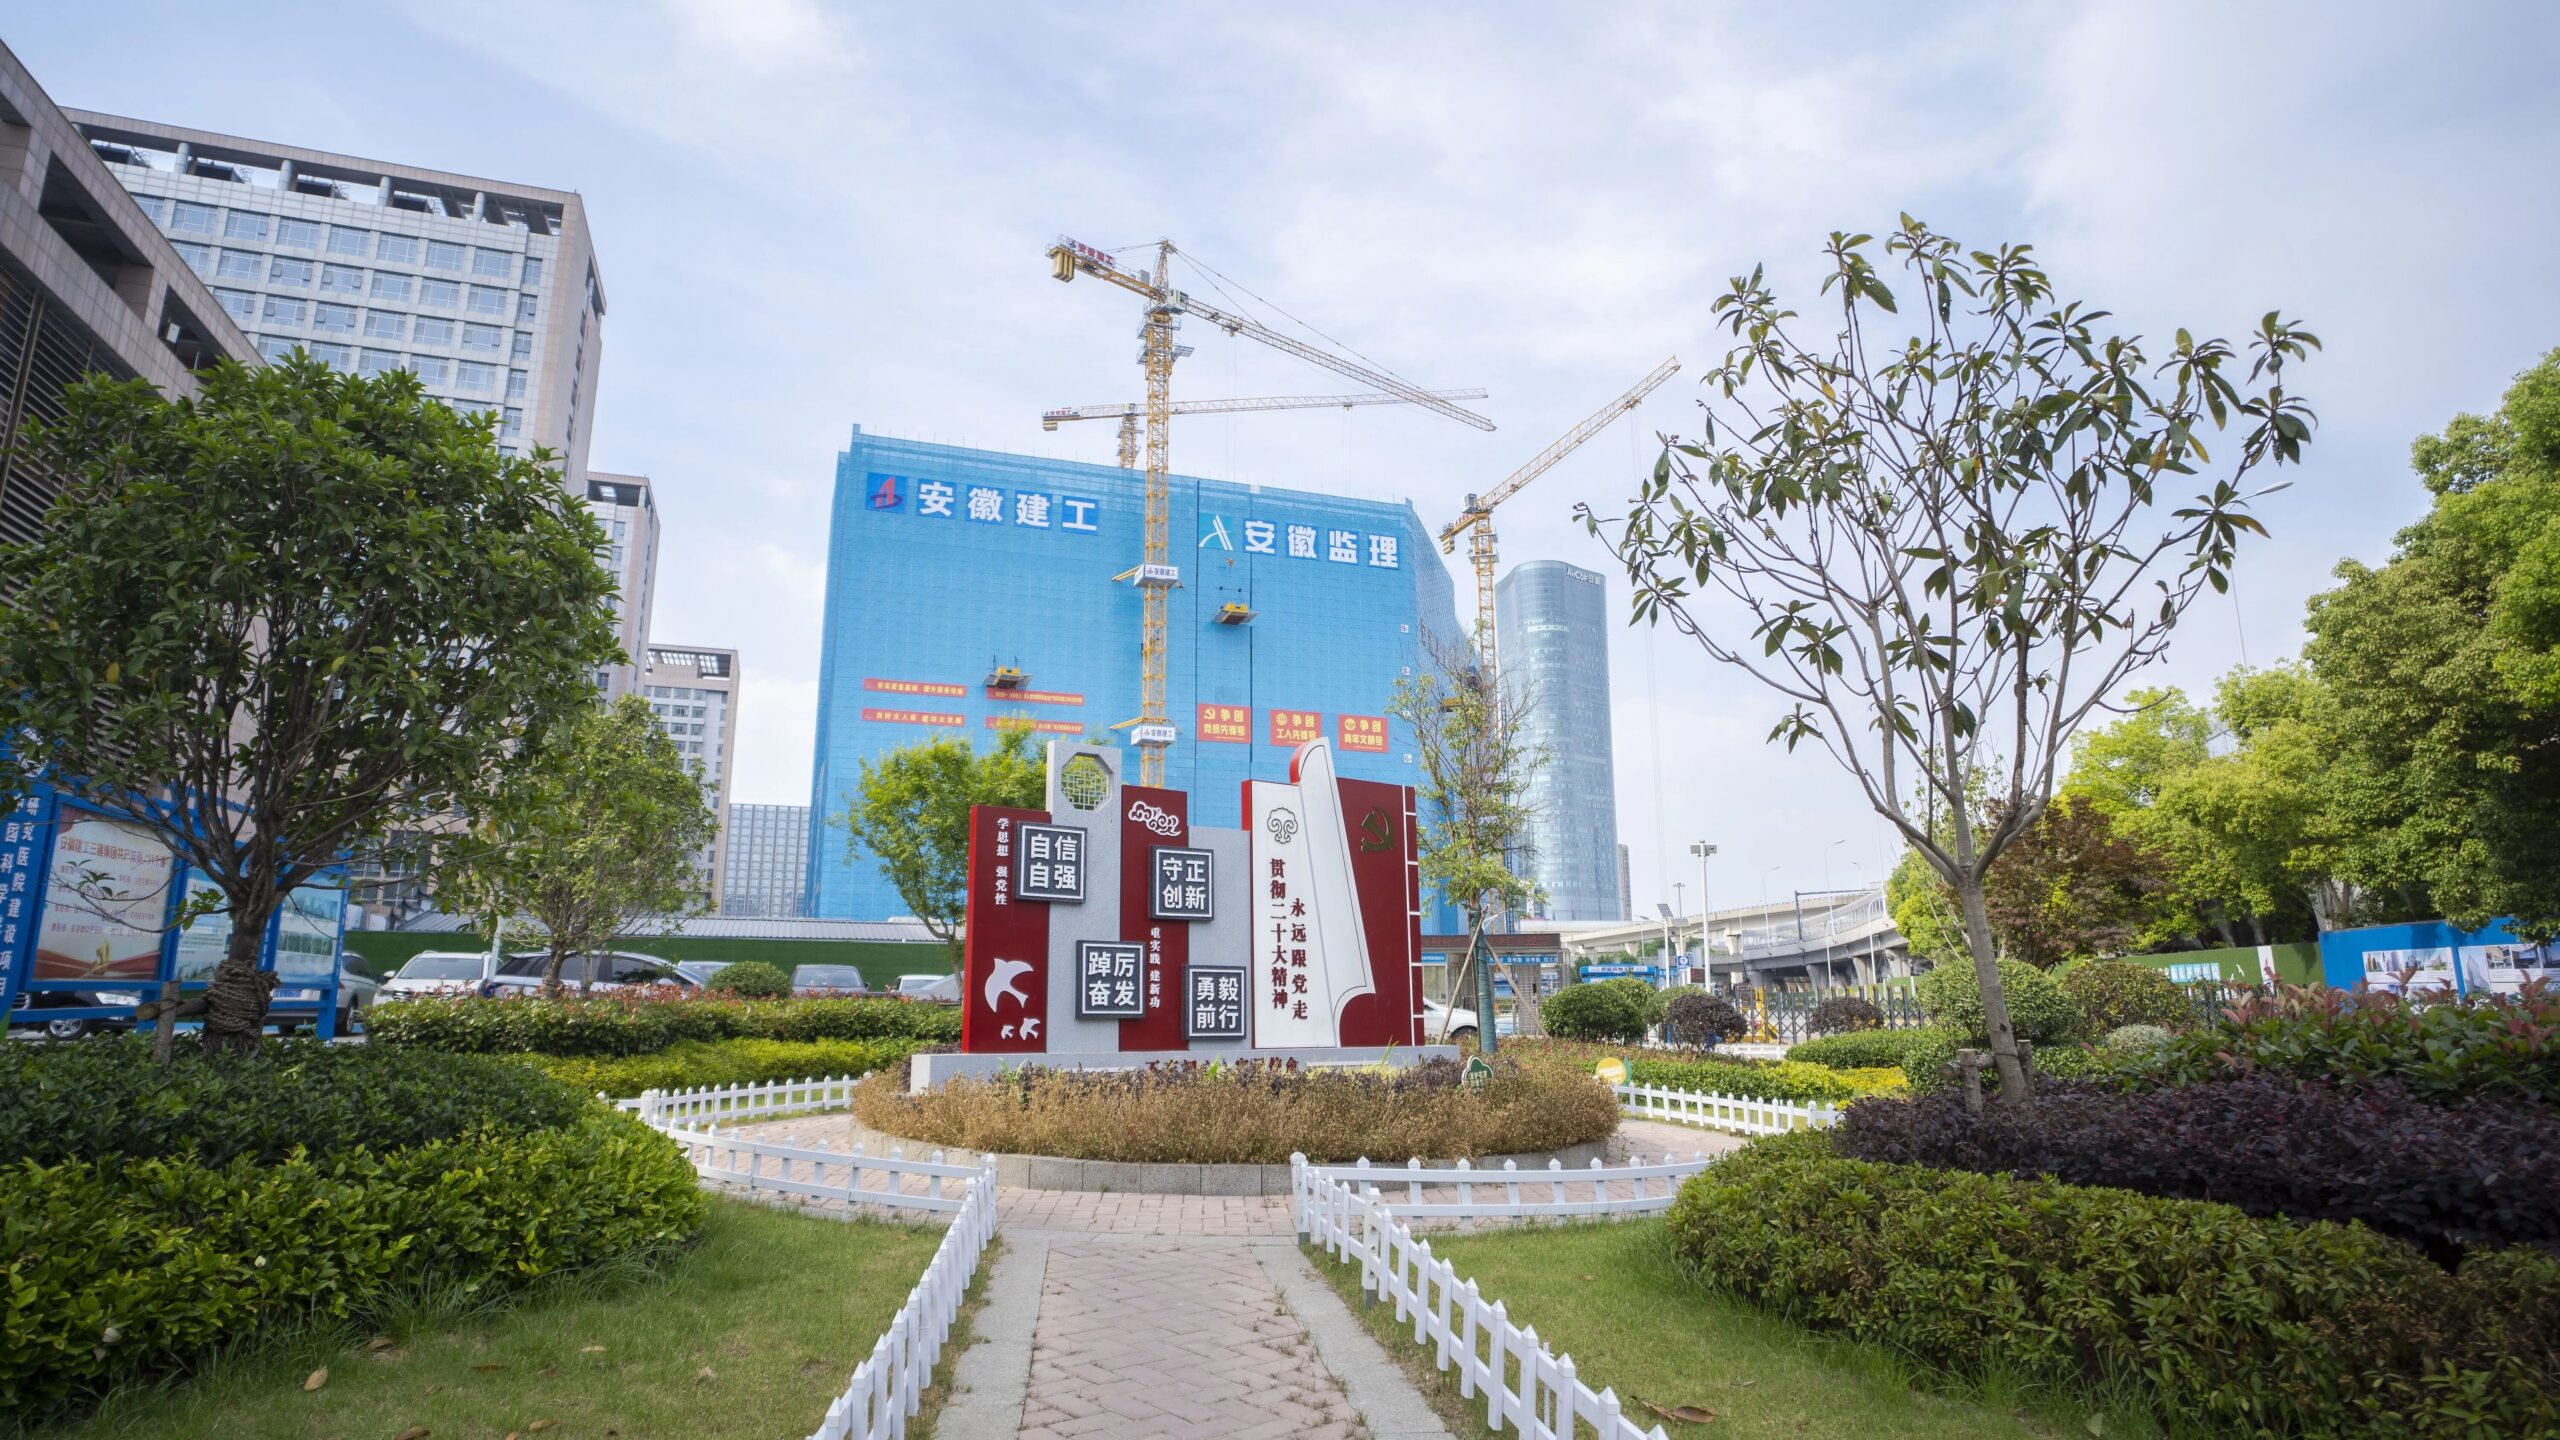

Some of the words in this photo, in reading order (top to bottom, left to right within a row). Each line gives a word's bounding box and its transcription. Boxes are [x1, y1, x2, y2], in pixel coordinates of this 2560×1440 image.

[918, 482, 1098, 532] 安徽建工
[1245, 521, 1398, 568] 安徽监理
[1154, 567, 1176, 576] 安徽建工
[1151, 729, 1173, 738] 安徽建工
[1204, 723, 1245, 737] 党员先锋号
[1276, 728, 1316, 741] 工人先锋号
[1344, 733, 1383, 747] 青年文明号
[996, 817, 1009, 858] 学思想
[1030, 833, 1078, 862] 自信
[1029, 863, 1077, 890] 自强
[1162, 858, 1206, 884] 守正
[995, 866, 1008, 906] 强党性
[1162, 885, 1206, 910] 创新
[1150, 928, 1161, 966] 重实践
[1270, 857, 1288, 1010] 贯彻二十大精神
[1089, 951, 1136, 978] 踔厉
[1290, 898, 1308, 1020] 永远跟党走
[1088, 979, 1136, 1007] 奋发
[1149, 970, 1161, 1009] 建新功
[1196, 976, 1239, 1002] 勇毅
[1196, 1002, 1239, 1029] 前行
